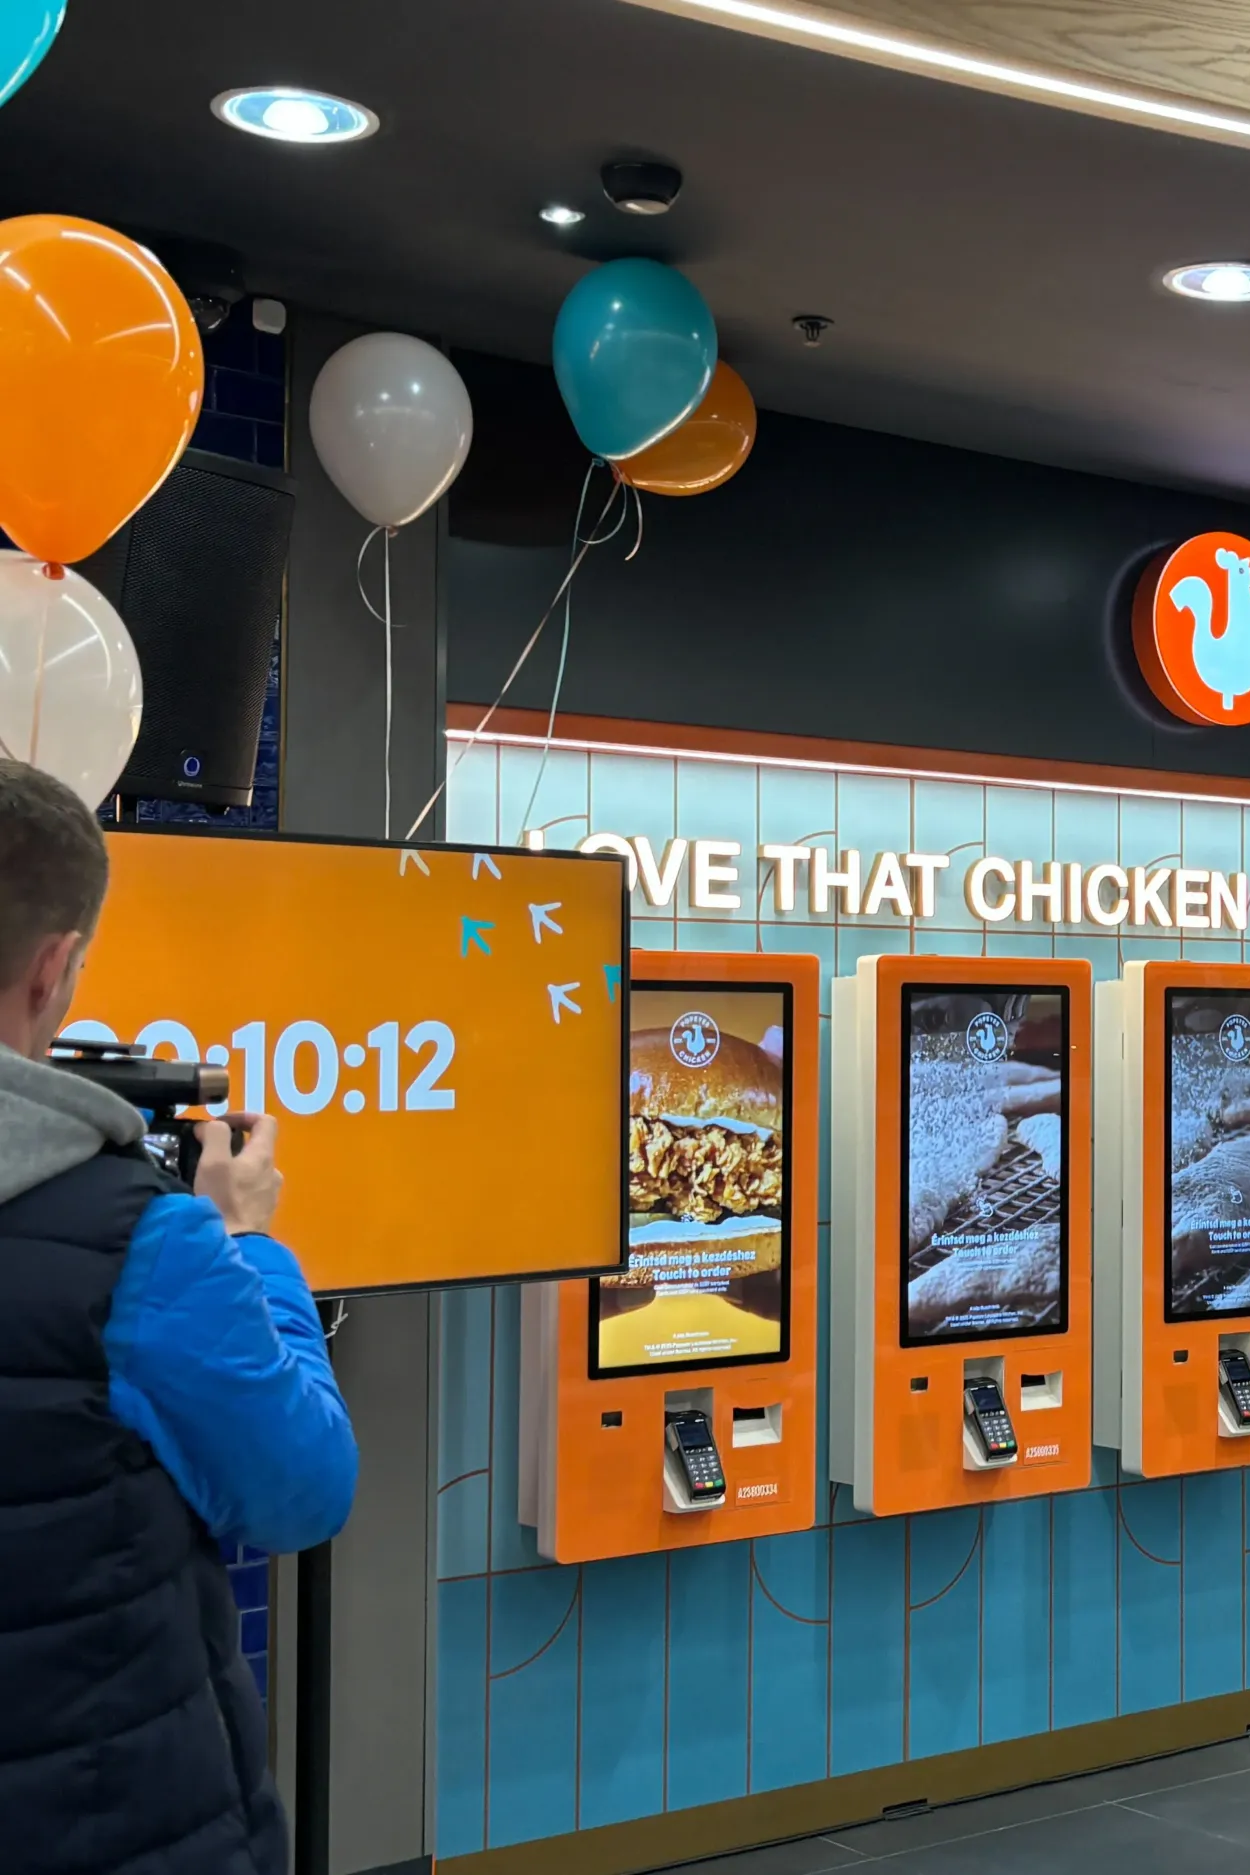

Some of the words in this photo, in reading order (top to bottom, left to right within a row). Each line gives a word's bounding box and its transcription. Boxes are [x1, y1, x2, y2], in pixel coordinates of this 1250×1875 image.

[529, 829, 742, 909] VE
[762, 844, 949, 917] THAT
[968, 855, 1248, 930] CHICKEN
[653, 1268, 686, 1280] Touch
[687, 1267, 701, 1279] to
[701, 1266, 731, 1277] order
